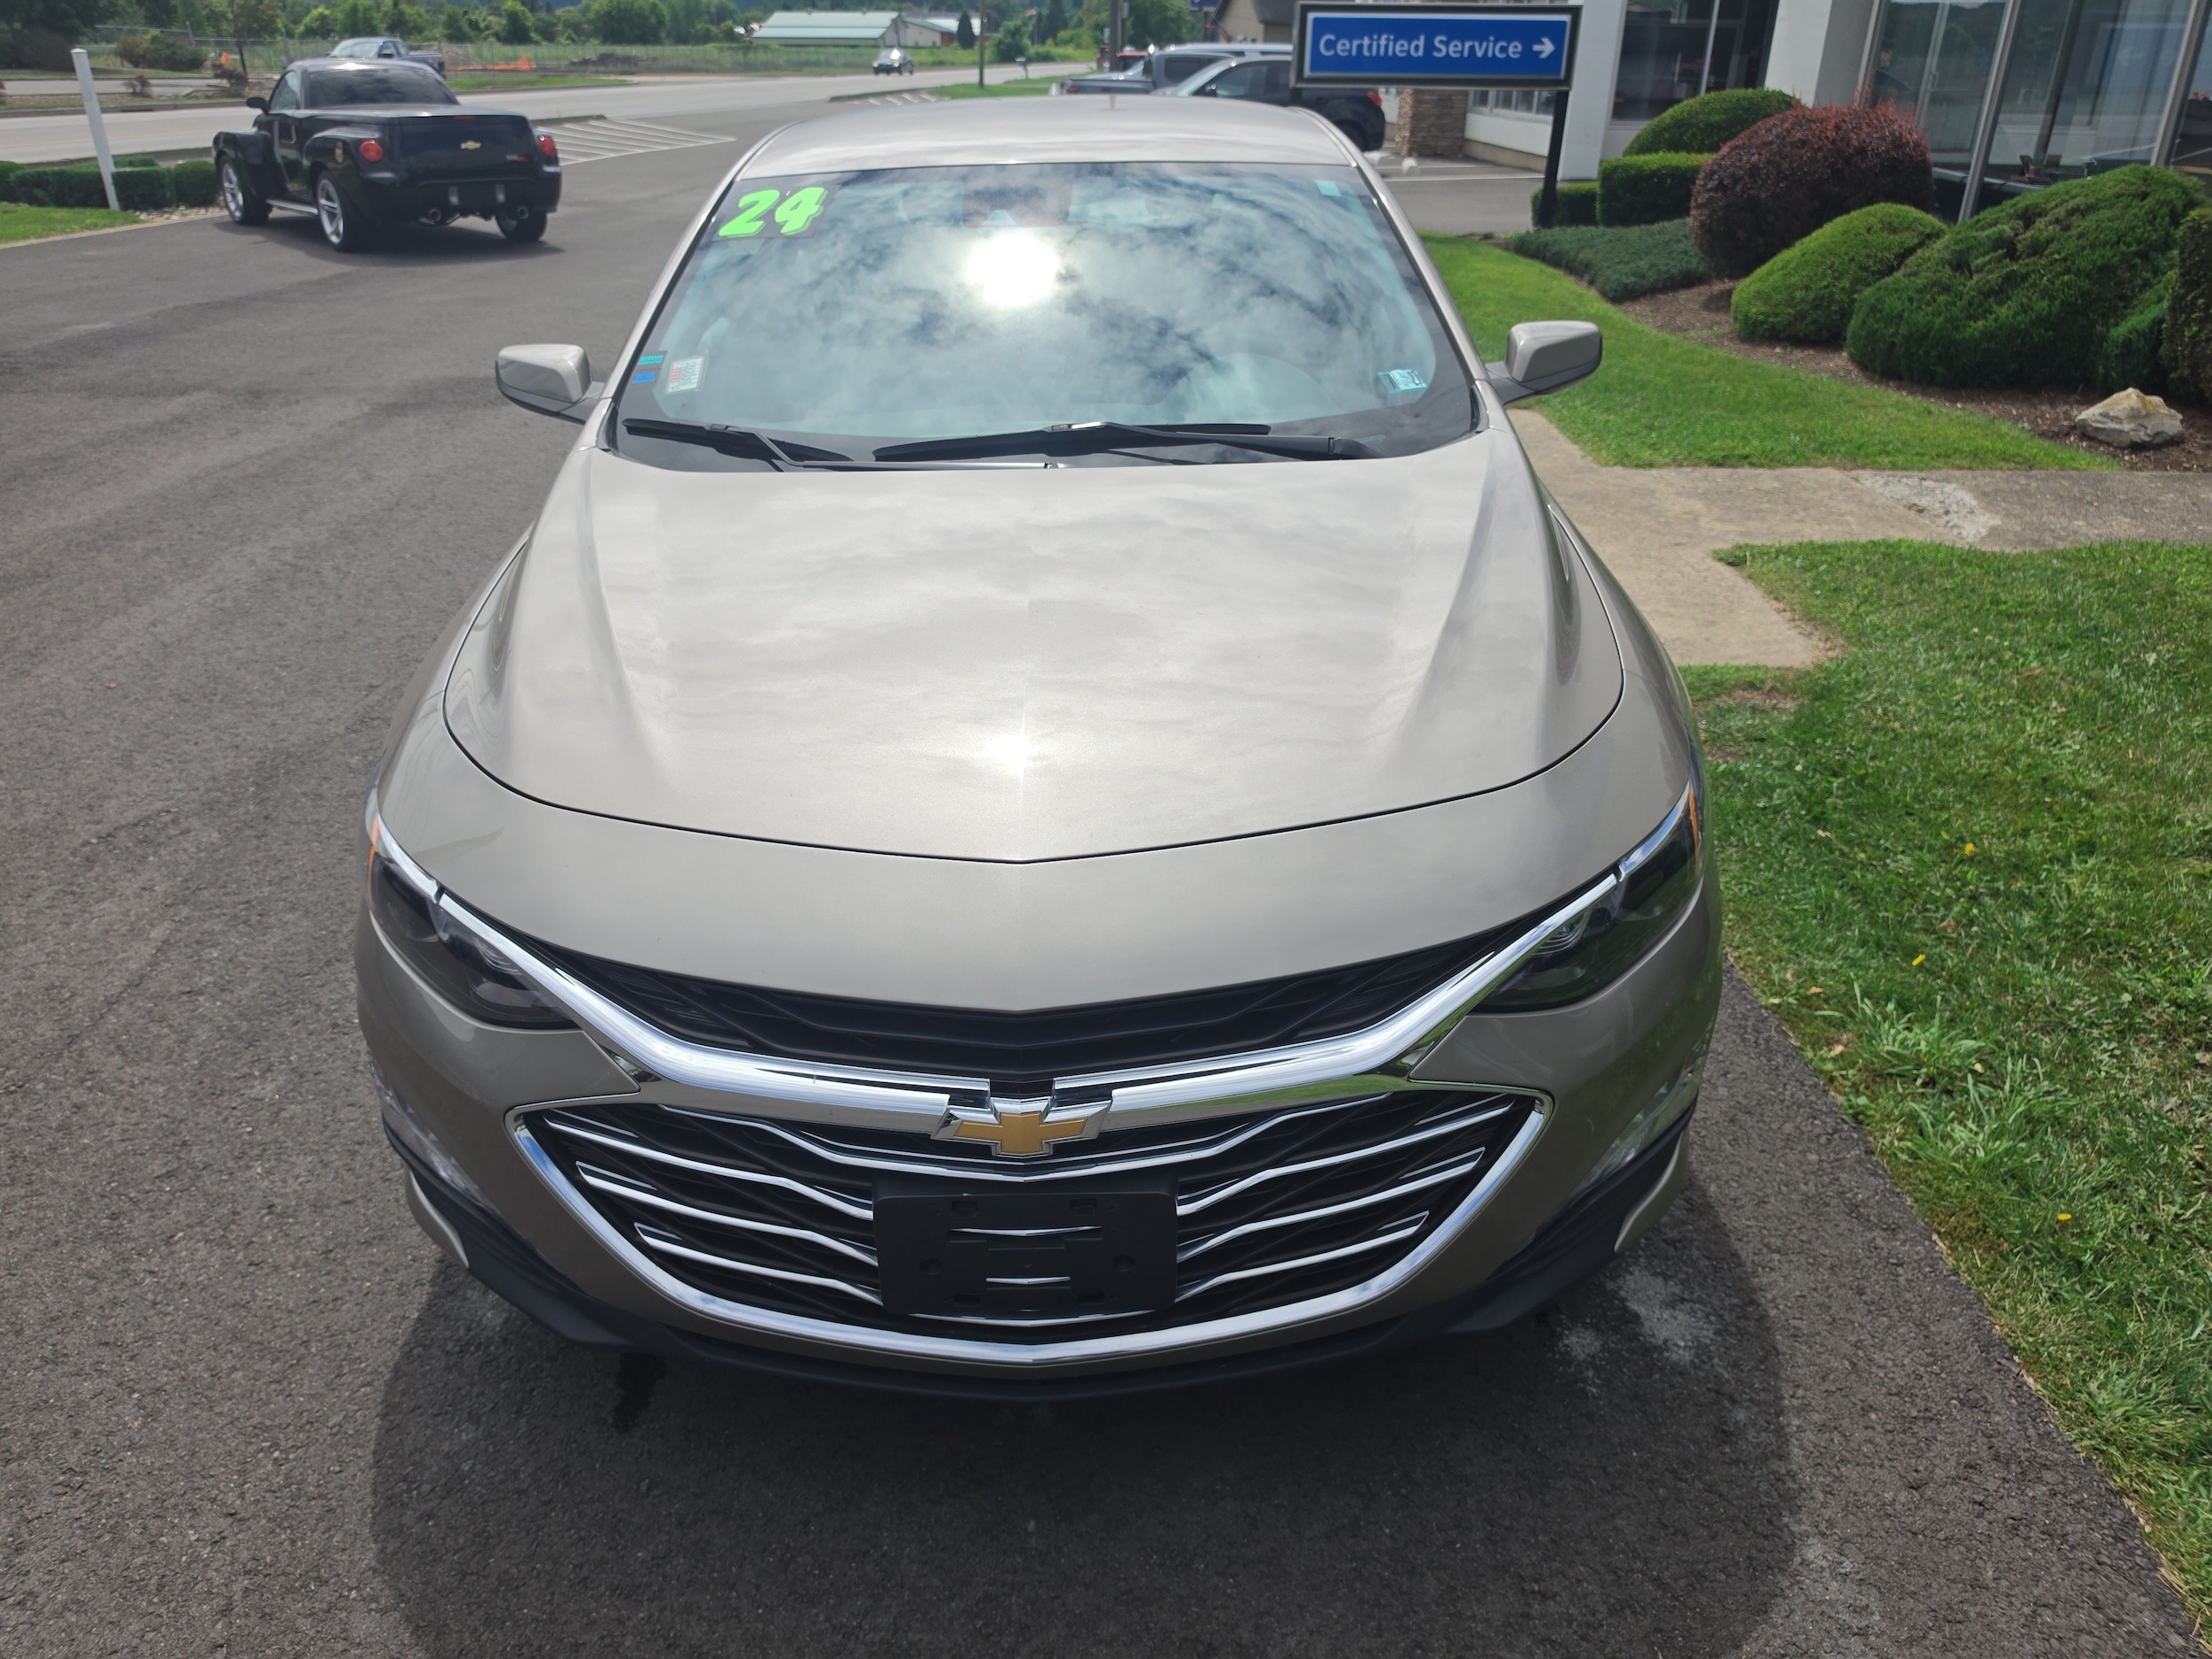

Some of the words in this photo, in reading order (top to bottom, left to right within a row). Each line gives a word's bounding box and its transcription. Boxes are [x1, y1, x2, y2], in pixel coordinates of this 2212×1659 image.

[1318, 34, 1425, 58] Certified
[1432, 35, 1522, 58] Service
[718, 187, 827, 238] 24
